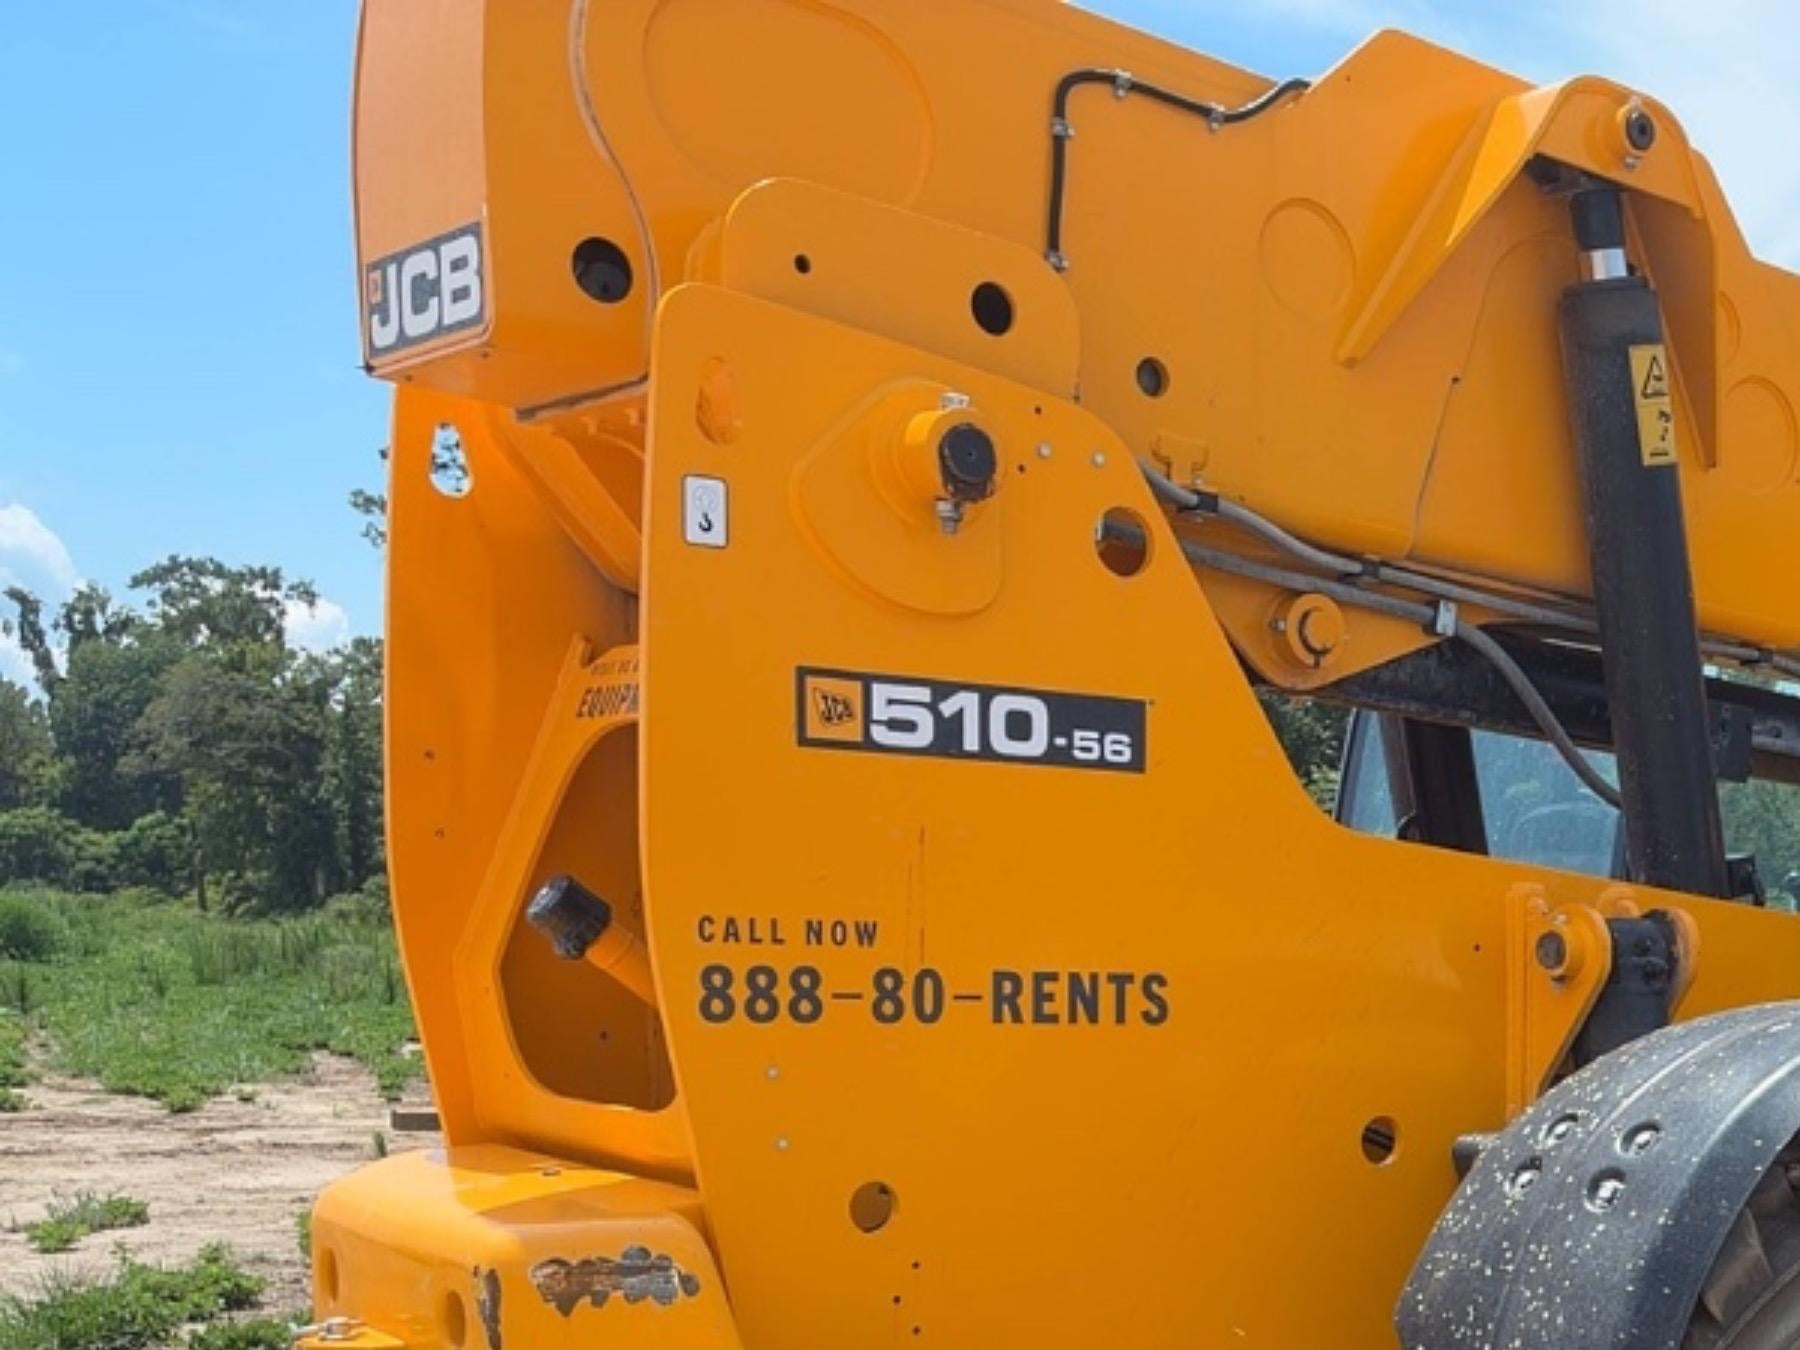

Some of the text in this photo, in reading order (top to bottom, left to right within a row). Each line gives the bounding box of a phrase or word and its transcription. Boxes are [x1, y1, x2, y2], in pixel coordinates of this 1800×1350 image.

[370, 234, 481, 349] JCB
[869, 682, 1133, 764] 510-56
[697, 915, 878, 948] CALL NOW
[699, 963, 1170, 1026] 888-80-RENTS
